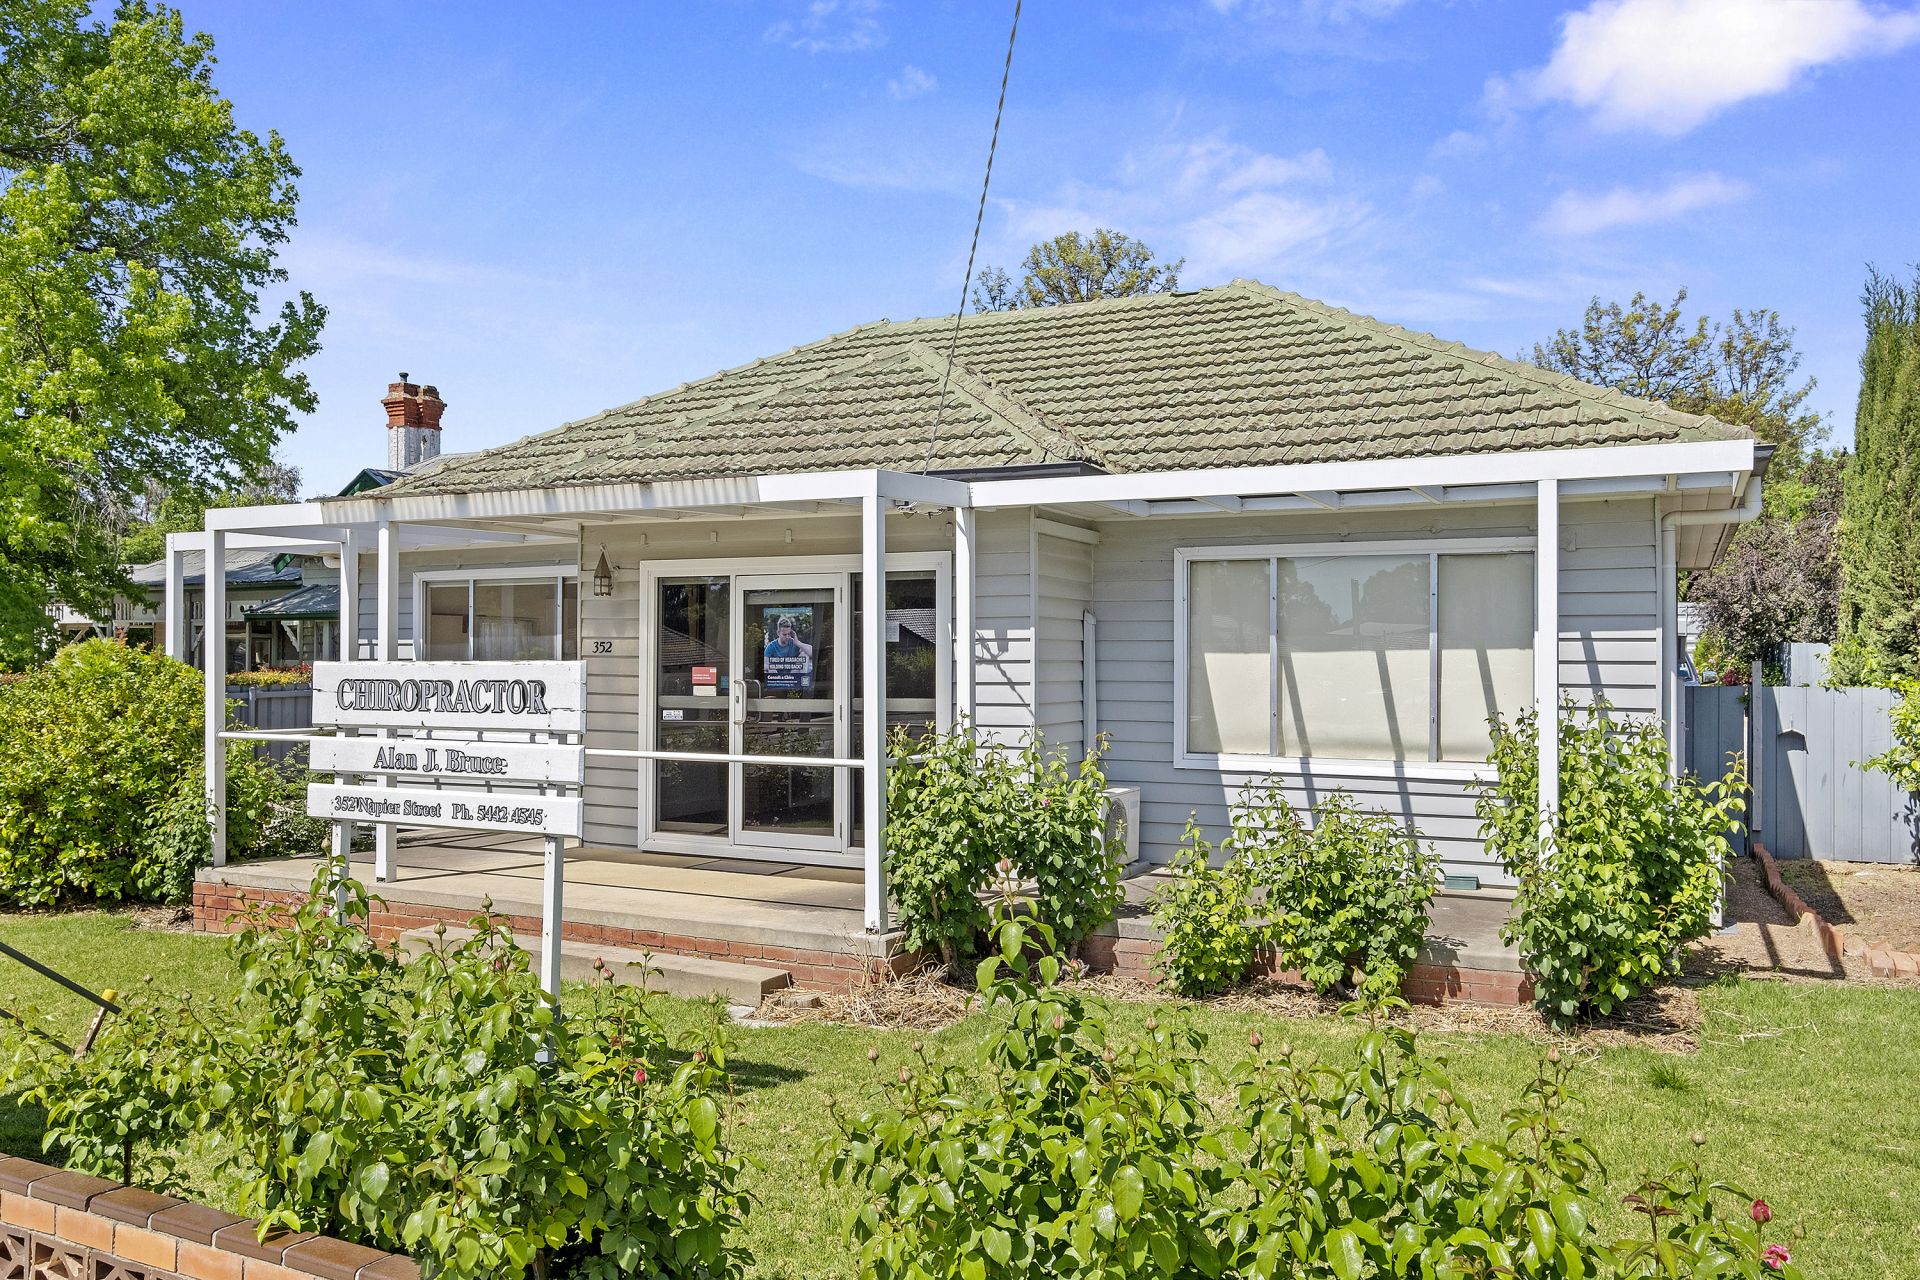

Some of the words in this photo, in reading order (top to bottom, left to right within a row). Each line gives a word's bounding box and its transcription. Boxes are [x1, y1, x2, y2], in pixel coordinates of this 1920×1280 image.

[592, 641, 612, 654] 352
[336, 678, 548, 715] CHIROPRACTOR
[374, 745, 418, 770] Alan
[422, 748, 442, 773] J.
[445, 749, 508, 775] Bruce
[334, 796, 358, 812] 352
[358, 797, 400, 817] Napier
[403, 800, 442, 818] Street
[451, 803, 474, 820] Ph.
[477, 805, 508, 822] 5442
[508, 807, 544, 826] 4545
